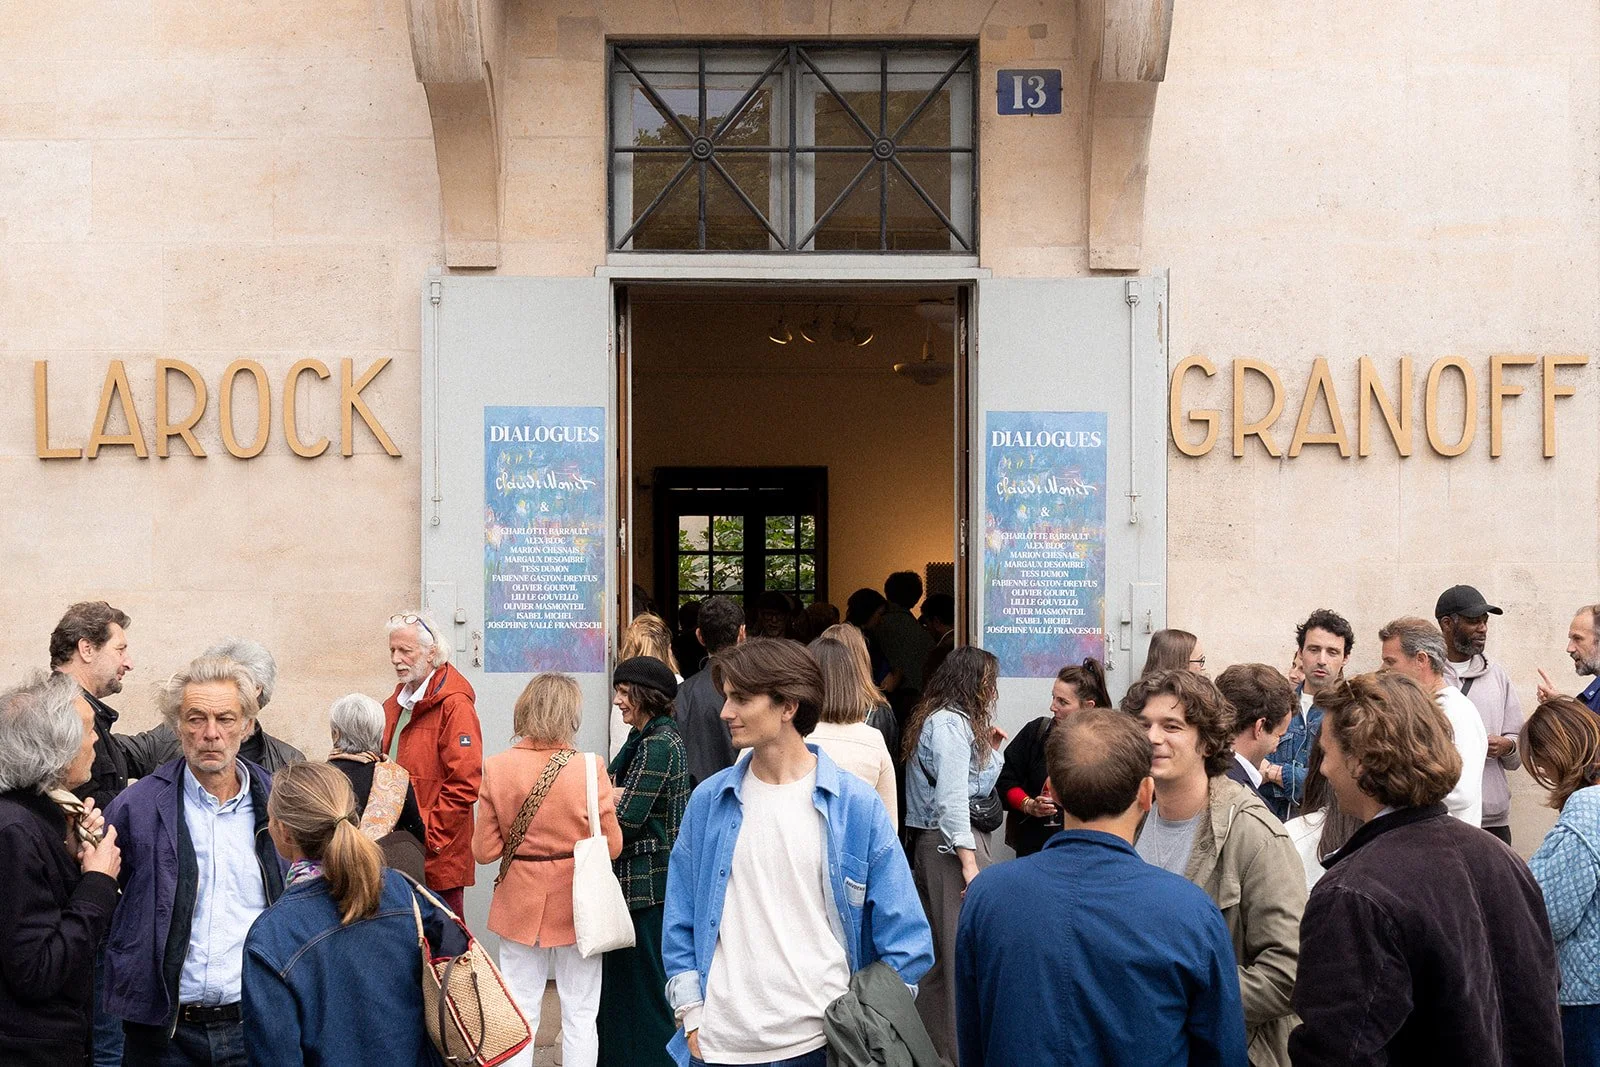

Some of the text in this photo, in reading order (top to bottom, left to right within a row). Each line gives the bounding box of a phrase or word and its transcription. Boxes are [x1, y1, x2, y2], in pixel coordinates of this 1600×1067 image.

[1012, 75, 1047, 109] 13
[34, 357, 401, 459] LAROCK
[1170, 353, 1589, 458] GRANOFF
[490, 426, 599, 442] DIALOGUES
[992, 431, 1101, 447] DIALOGUES
[540, 501, 549, 512] &
[1040, 507, 1049, 517] &
[525, 537, 566, 545] ALEX BLOC
[1024, 542, 1066, 550] ALEX BLOC
[521, 565, 569, 573] TESS DUMON
[992, 580, 1098, 588] FABIENNE GASTON-DREYFUS
[517, 612, 573, 620] ISABEL MICHEL
[487, 621, 602, 629] JOSÉPHINE VALLÉ FRANCESCHI
[987, 626, 1102, 634] JOSÉPHINE VALLÉ FRANCESCHI
